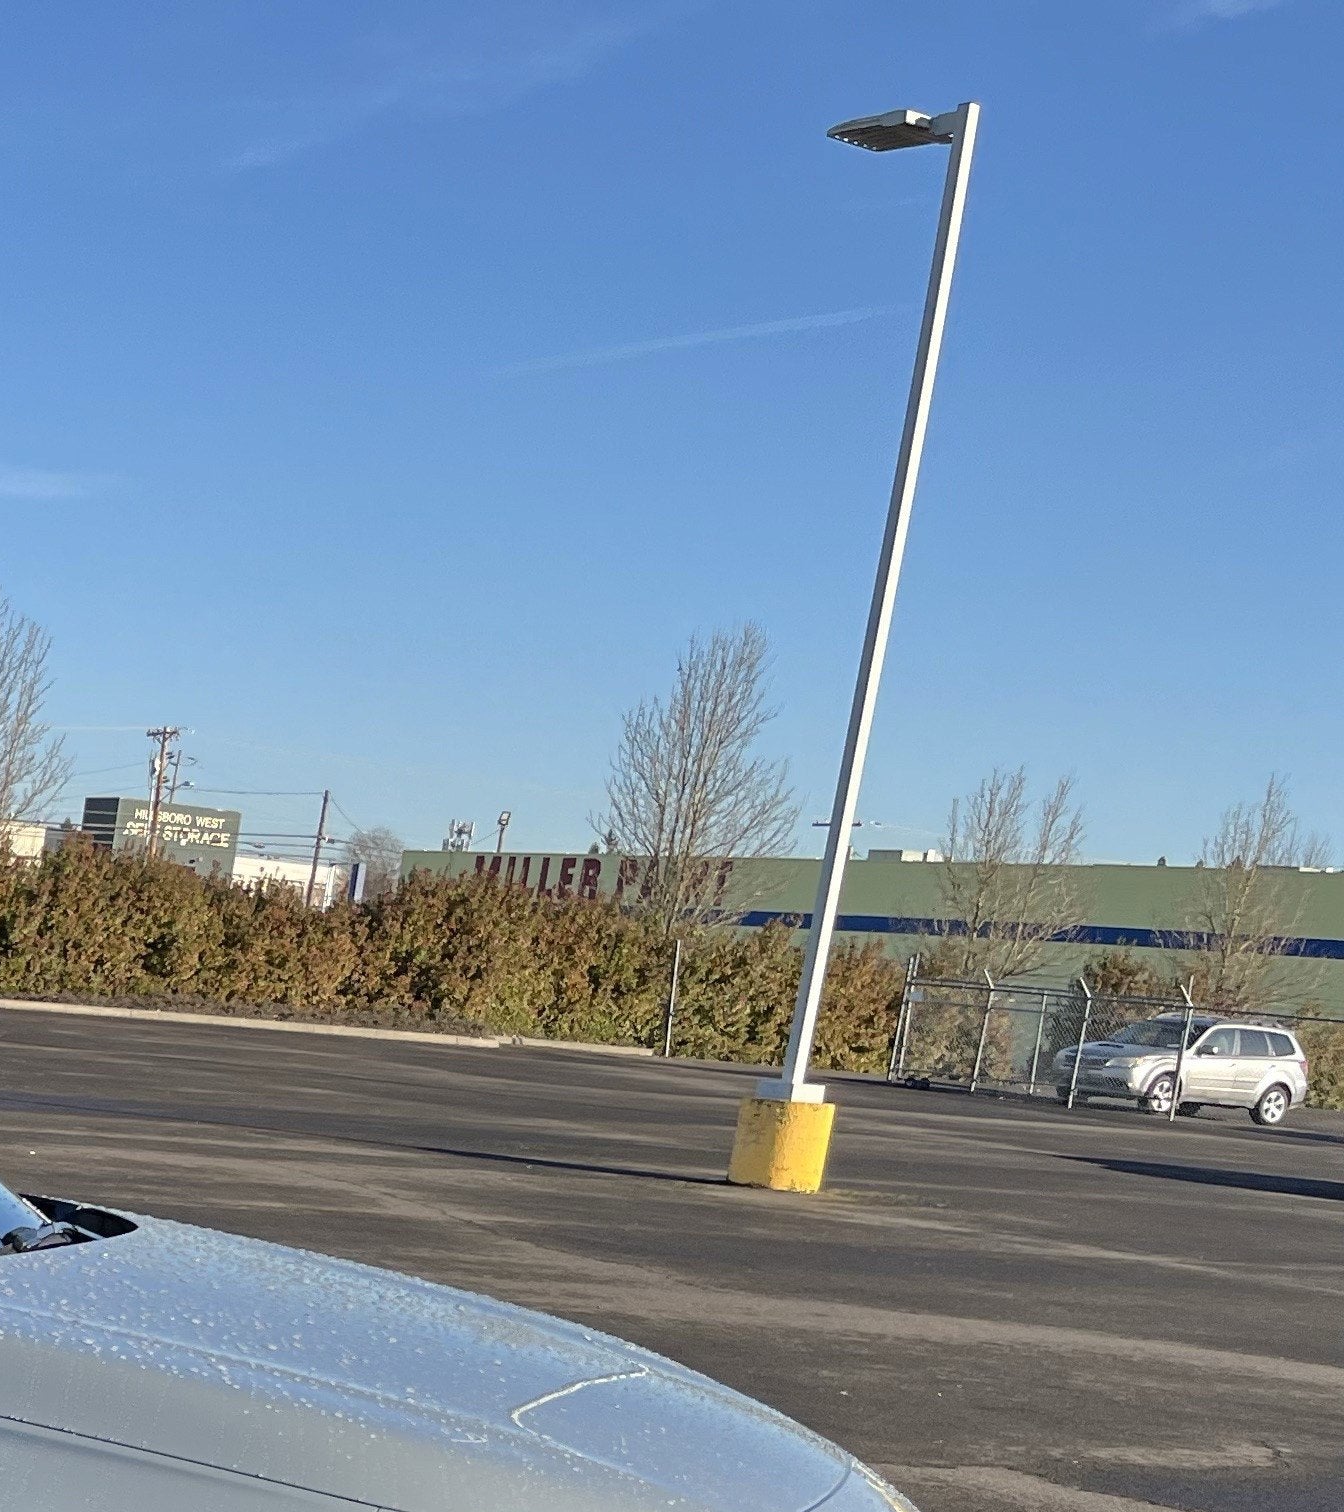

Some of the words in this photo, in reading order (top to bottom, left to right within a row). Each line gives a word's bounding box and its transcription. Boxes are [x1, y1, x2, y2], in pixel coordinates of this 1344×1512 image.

[134, 809, 192, 825] HILSBORO
[196, 816, 226, 829] WEST
[122, 821, 161, 836] SEL
[162, 825, 230, 847] STORAGE
[474, 855, 602, 901] MILLER
[613, 857, 734, 907] PAT
